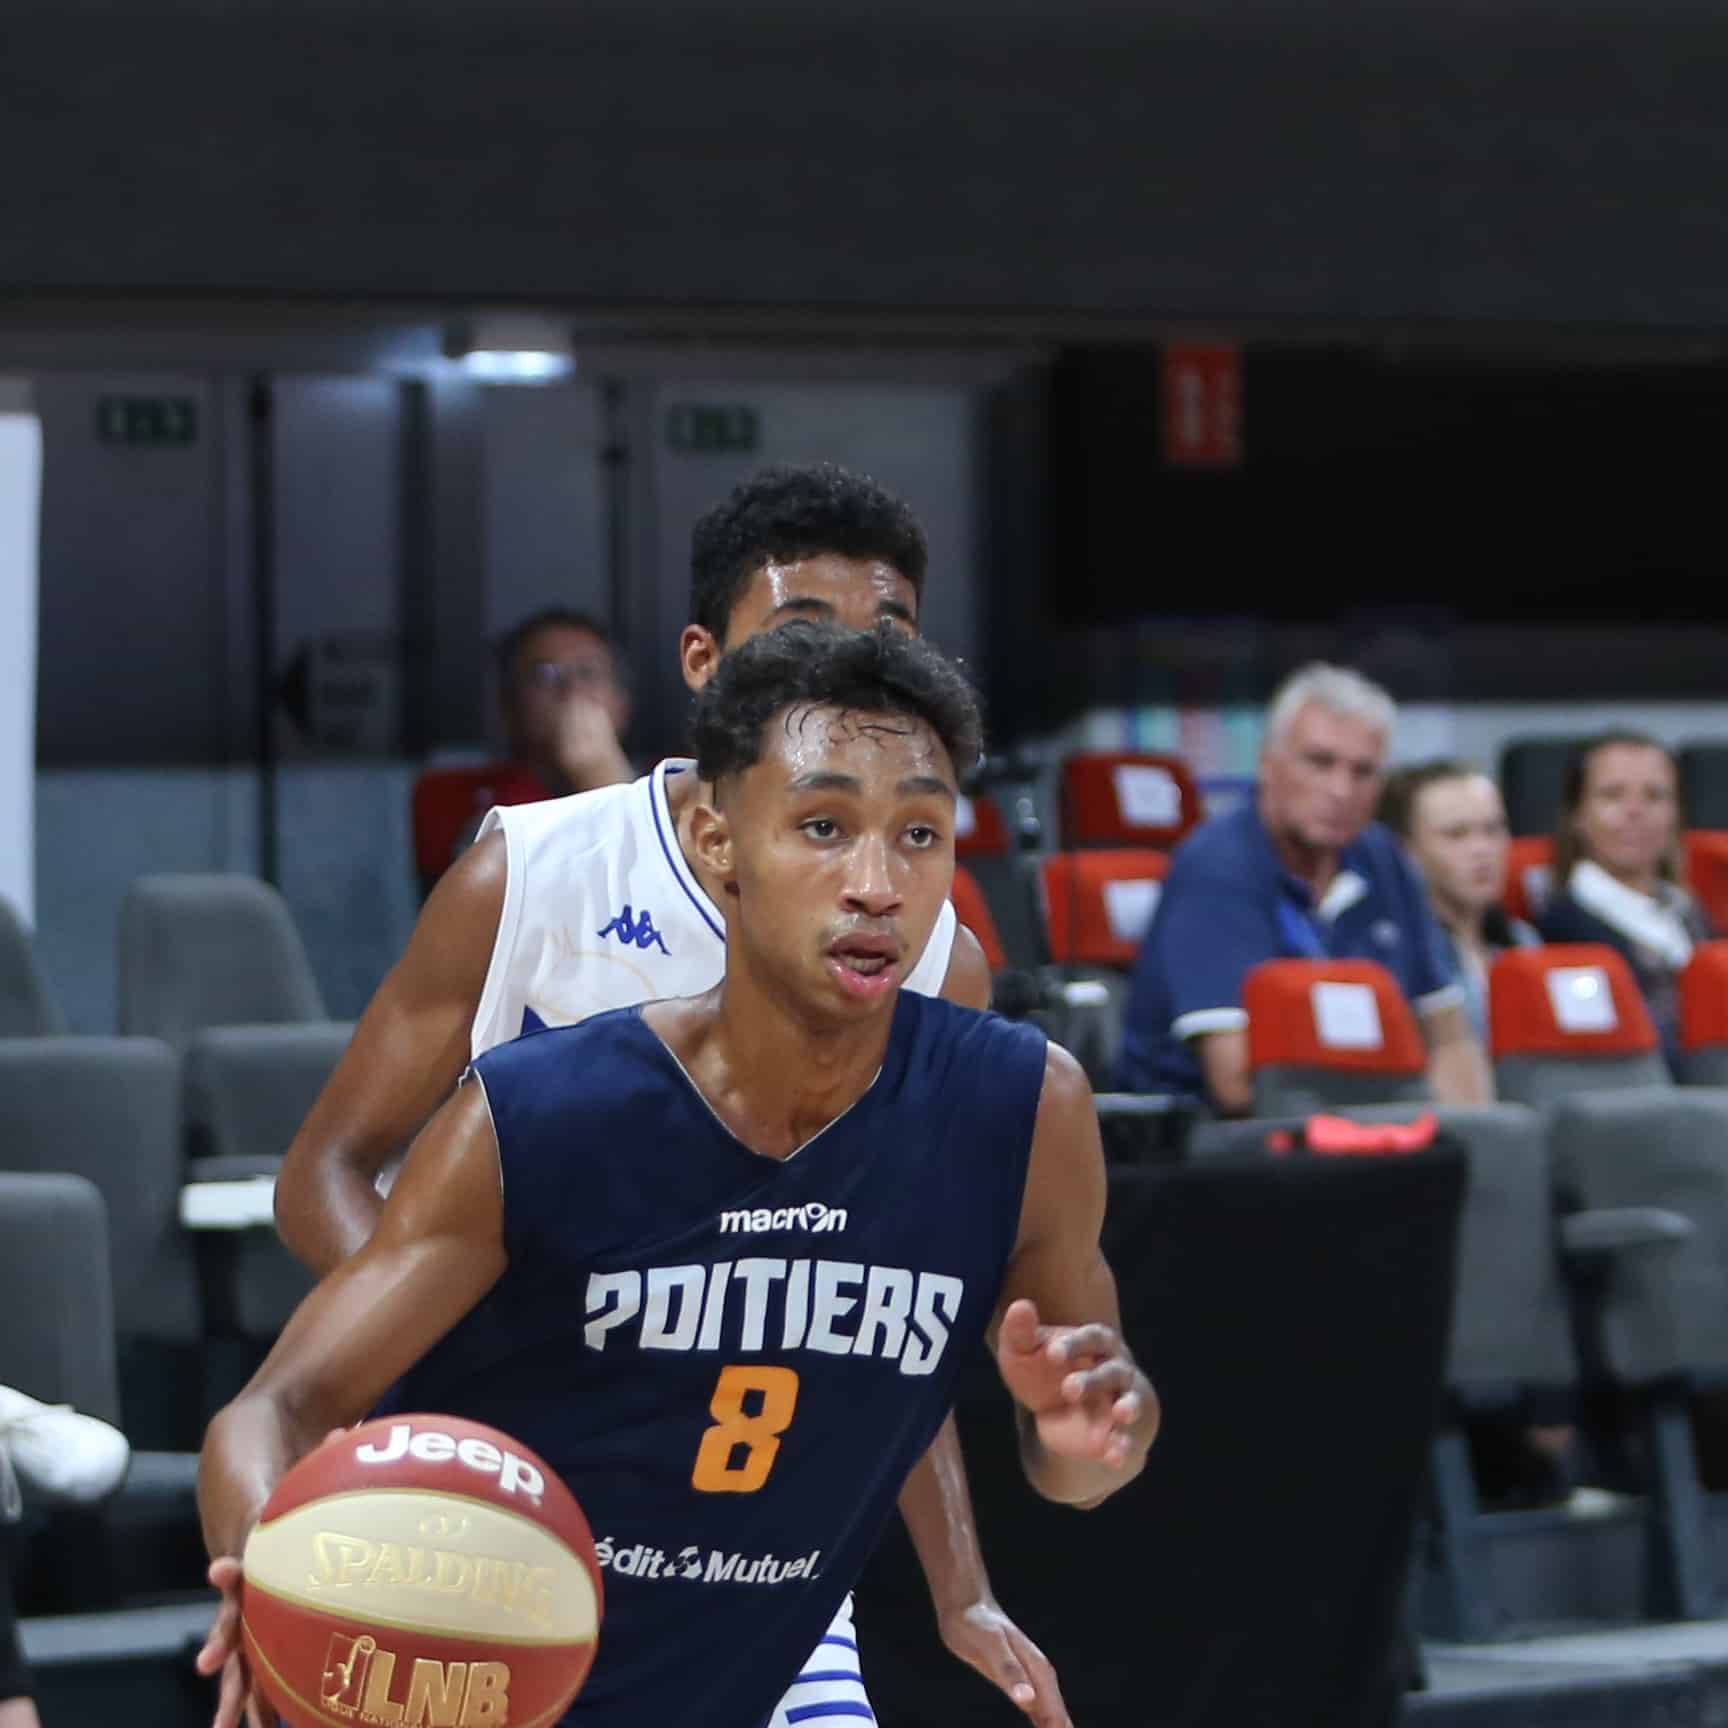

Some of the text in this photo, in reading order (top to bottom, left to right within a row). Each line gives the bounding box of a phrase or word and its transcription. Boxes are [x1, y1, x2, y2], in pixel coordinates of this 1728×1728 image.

[583, 1257, 964, 1377] POITIERS
[355, 1424, 547, 1497] Jeep
[691, 1365, 800, 1494] 8
[593, 1537, 665, 1579] édit
[363, 1648, 512, 1728] LNB
